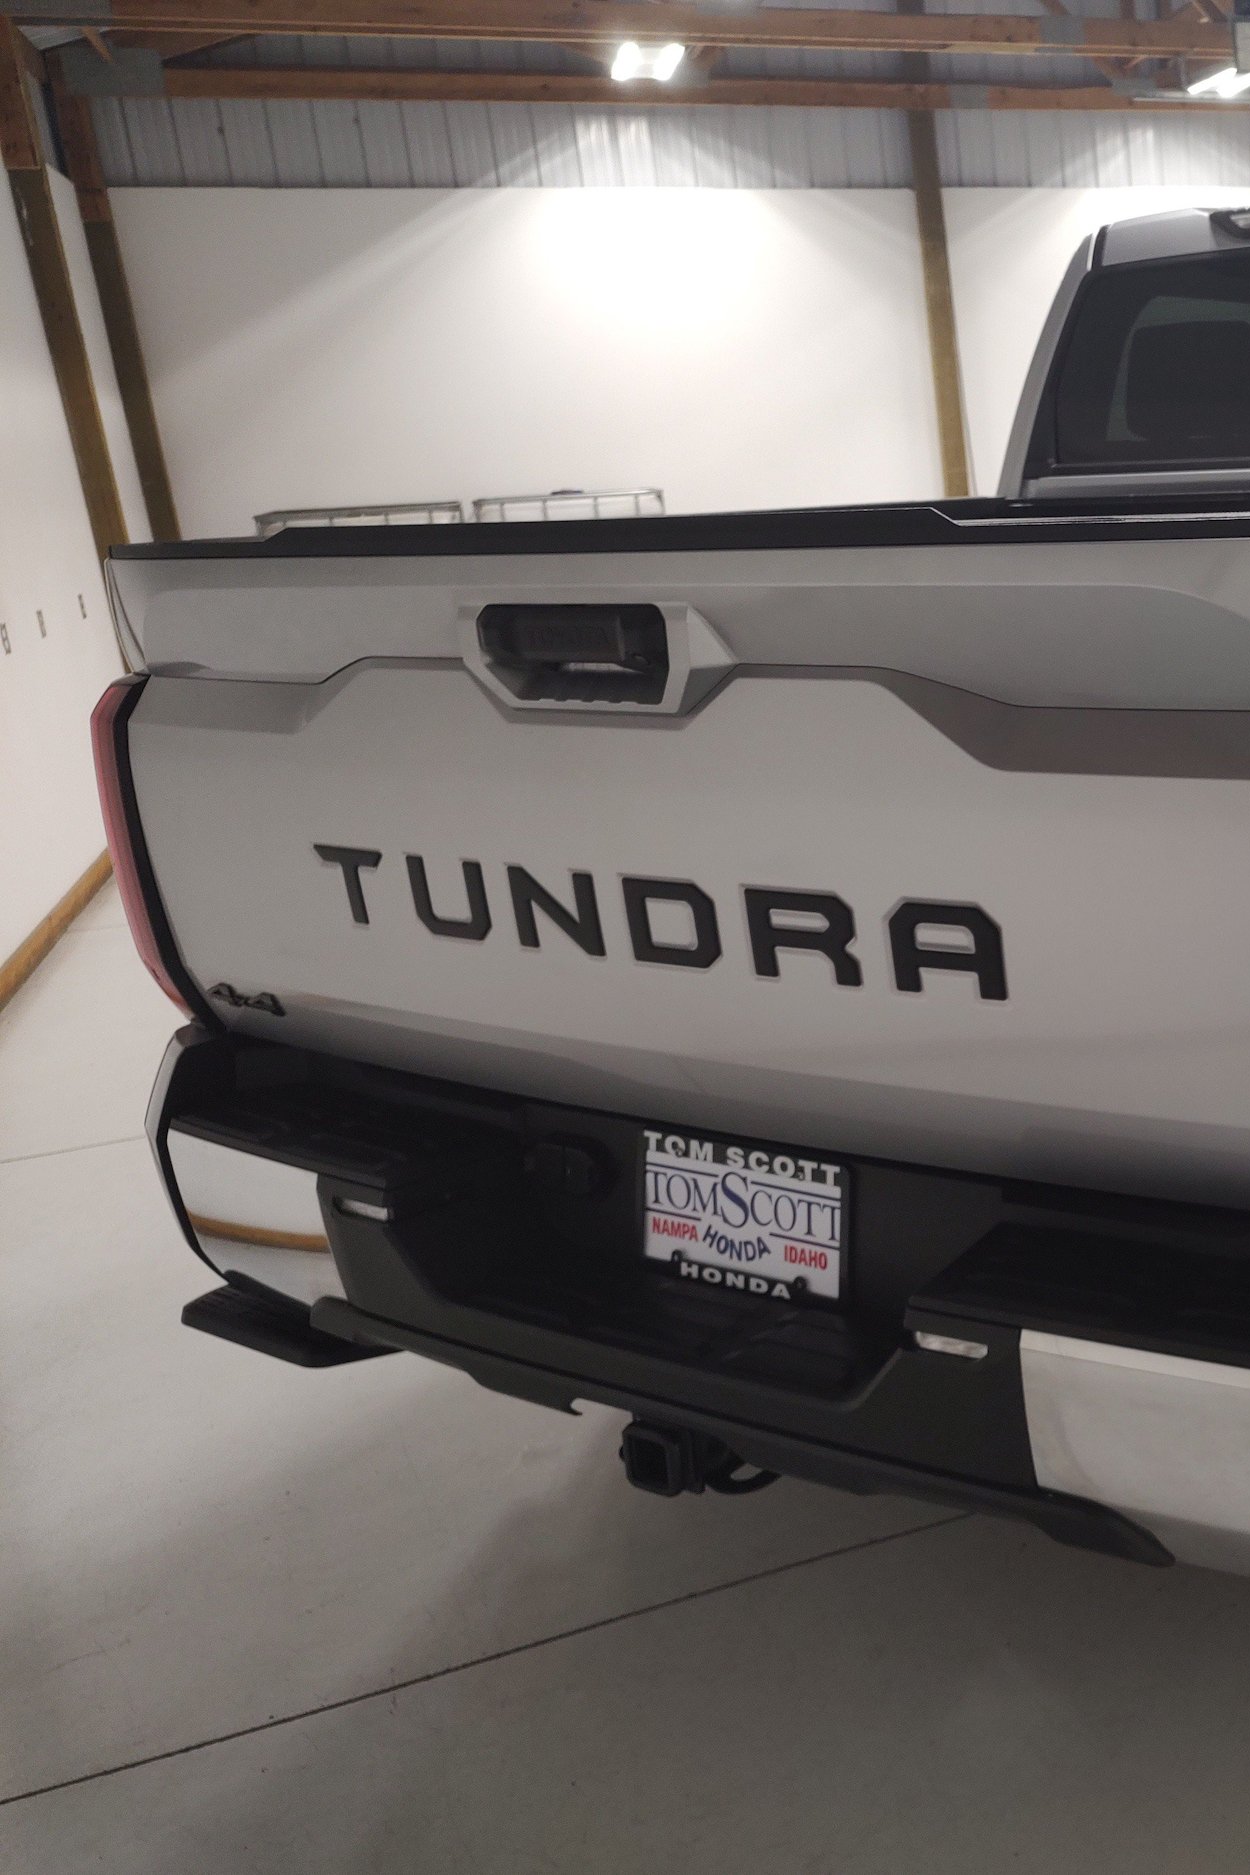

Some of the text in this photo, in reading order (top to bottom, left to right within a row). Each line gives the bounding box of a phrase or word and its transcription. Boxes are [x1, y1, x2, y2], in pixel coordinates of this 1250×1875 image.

[311, 842, 1010, 1003] TUNDRA
[643, 1129, 841, 1188] TOM SCOTT
[651, 1216, 699, 1242] NAMPA
[702, 1224, 772, 1263] HONDA
[784, 1244, 828, 1271] IDAHO
[680, 1261, 791, 1300] HONDA
